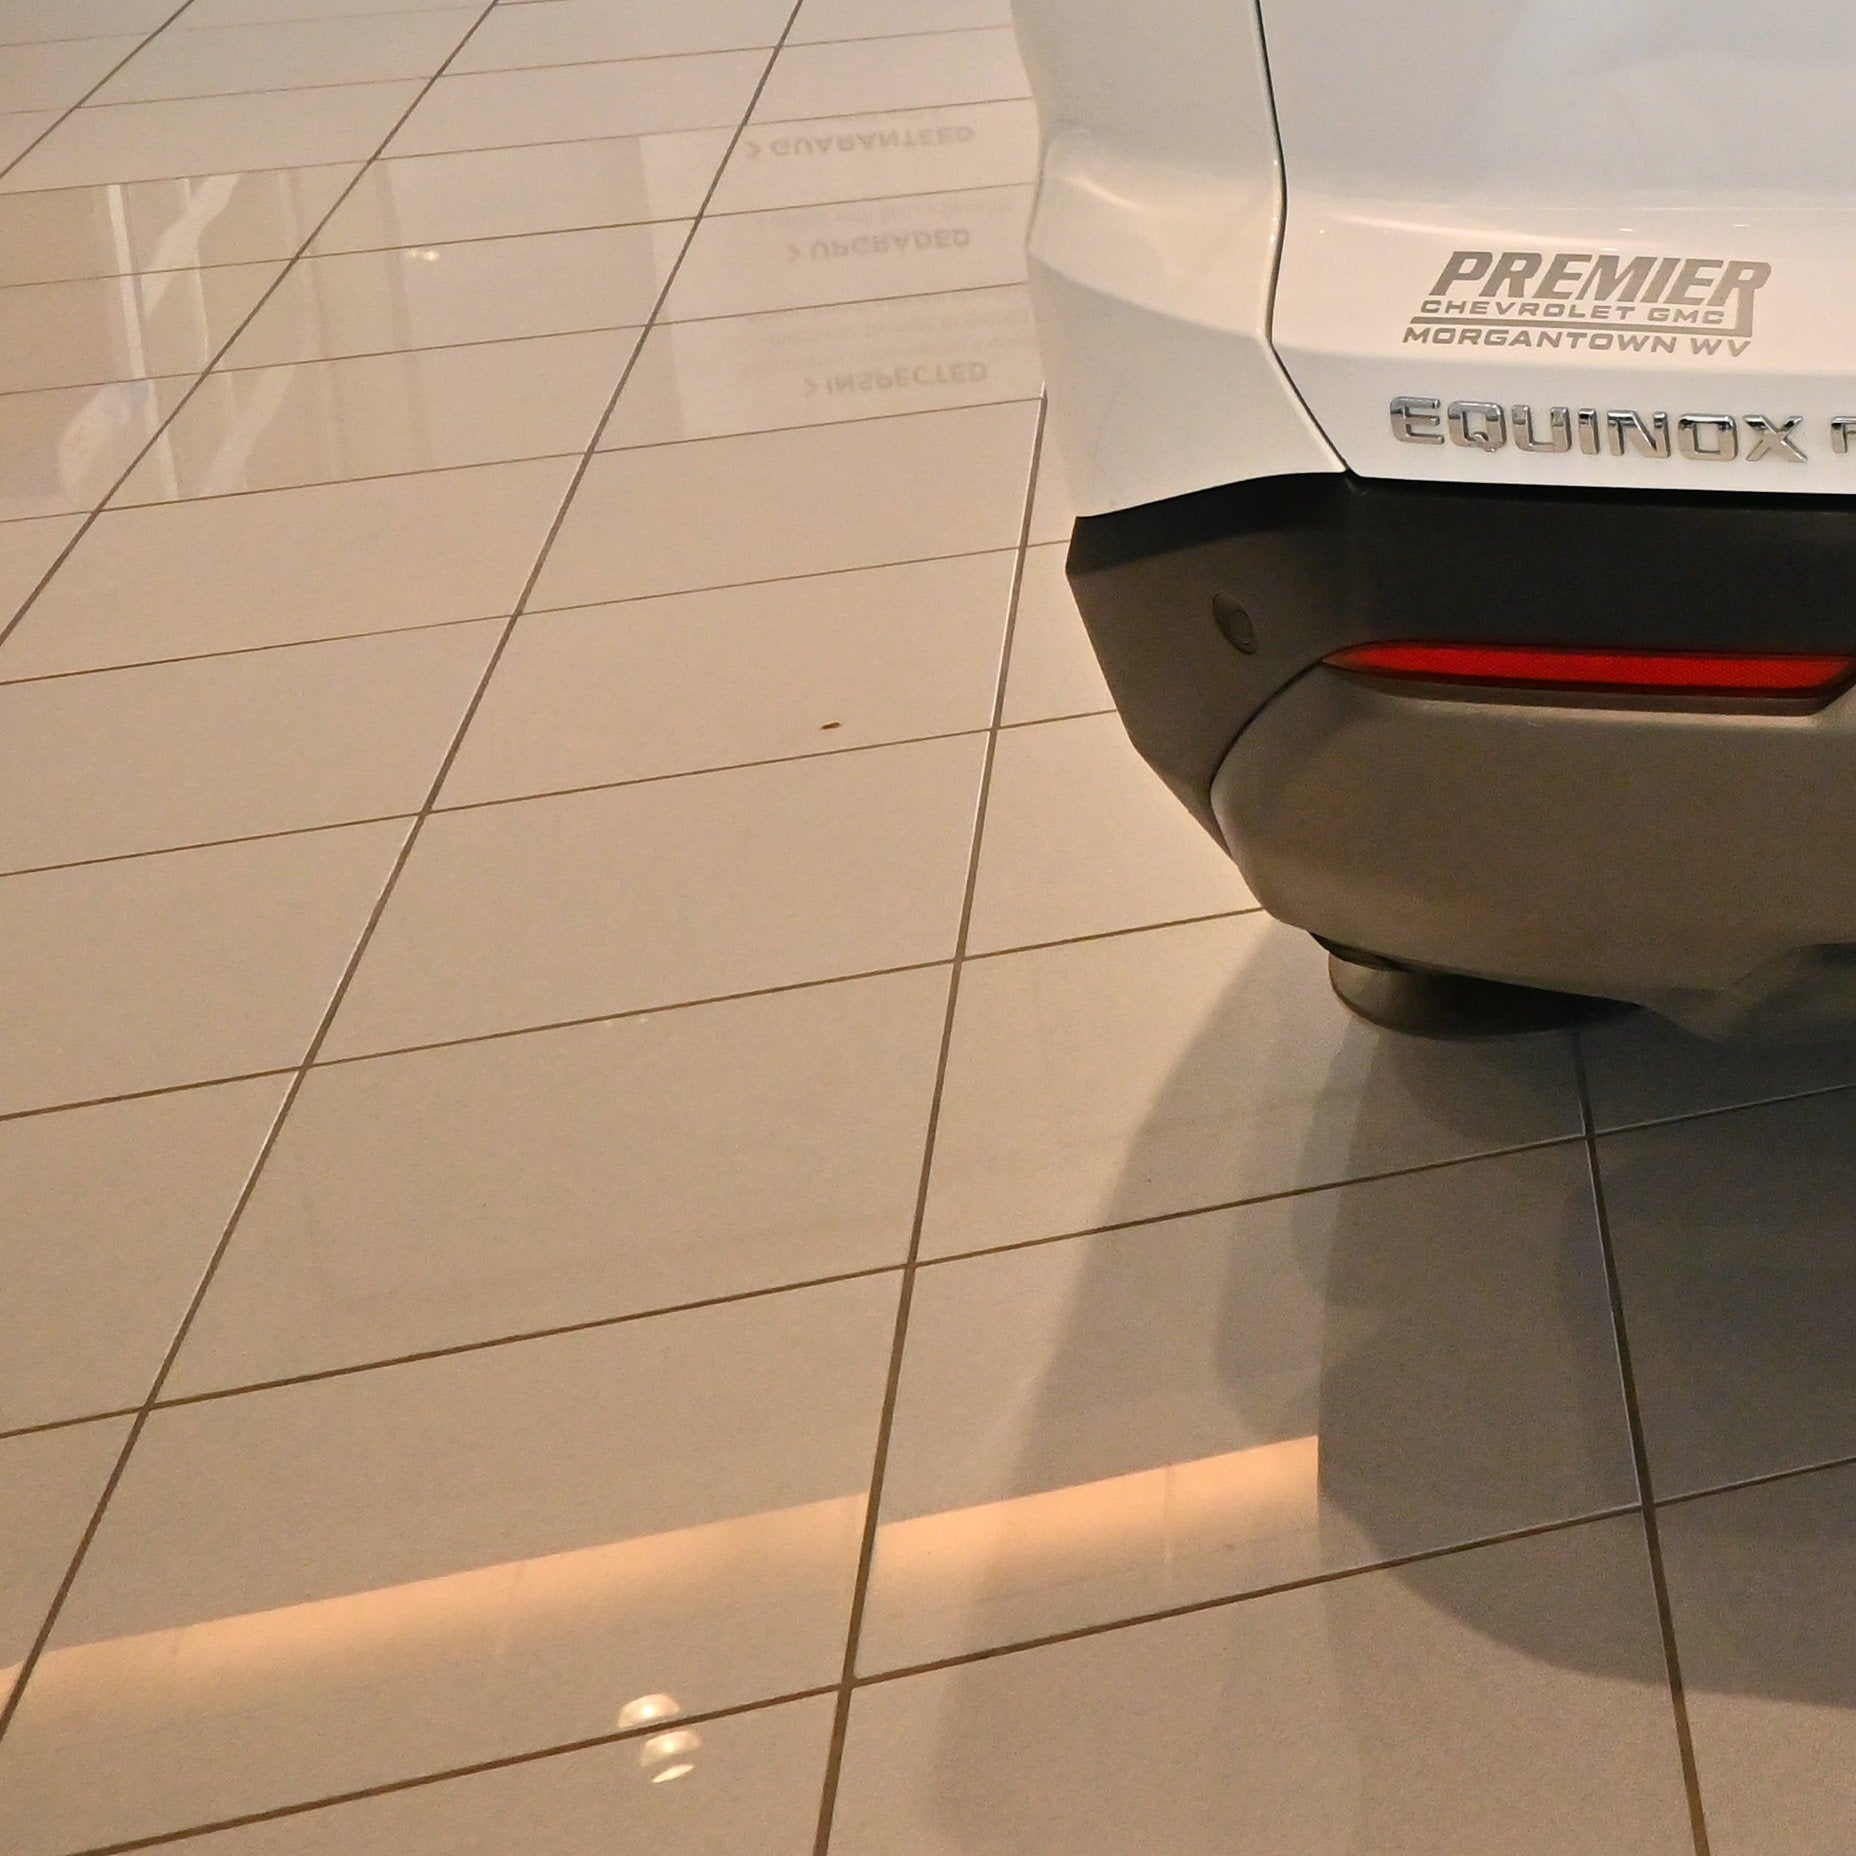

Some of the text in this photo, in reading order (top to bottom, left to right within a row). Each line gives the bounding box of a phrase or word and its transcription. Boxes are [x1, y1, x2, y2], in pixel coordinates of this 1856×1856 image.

[1420, 300, 1725, 325] CHEVROLET GMC
[1429, 251, 1772, 337] PREMIER
[1402, 326, 1752, 357] MORGANTOWN WV
[1389, 395, 1808, 463] EQUINOX
